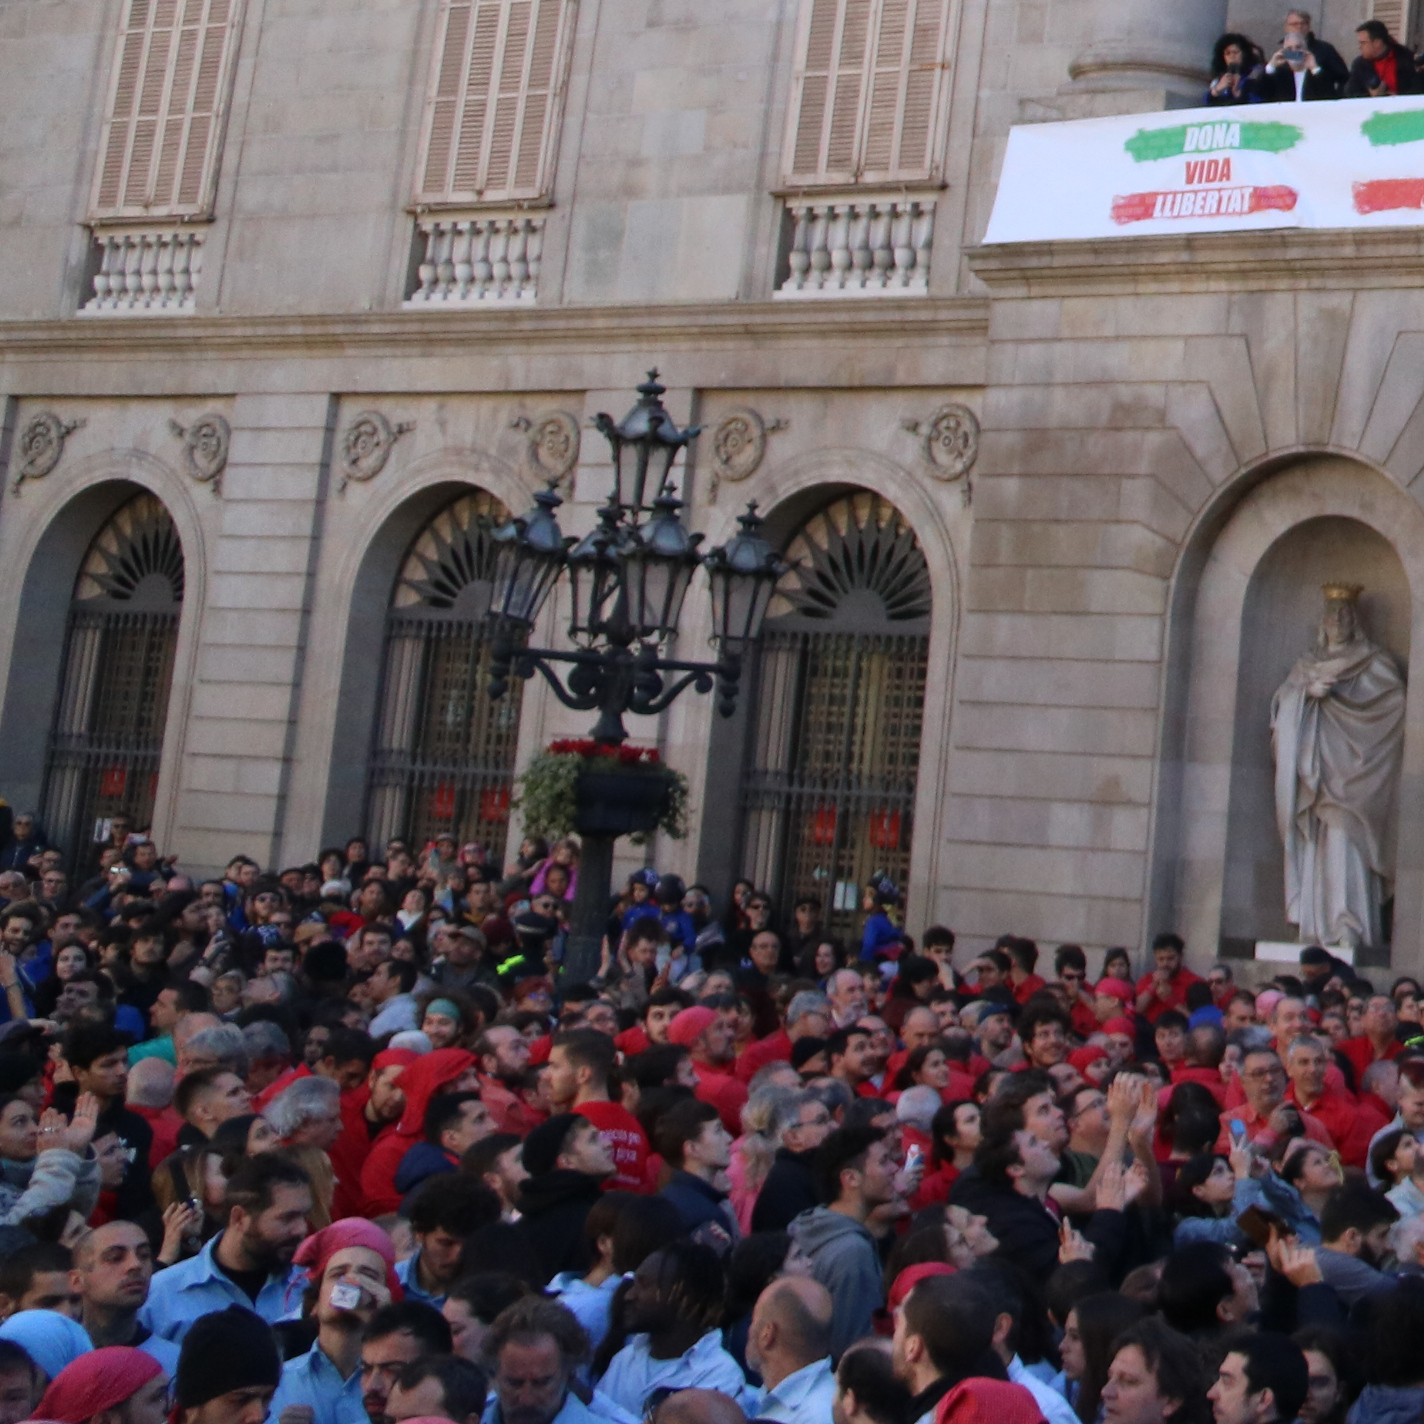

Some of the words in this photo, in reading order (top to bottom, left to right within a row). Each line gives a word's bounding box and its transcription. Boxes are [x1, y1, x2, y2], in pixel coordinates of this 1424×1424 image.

[1183, 122, 1240, 152] DONA
[1185, 157, 1232, 185] VIDA
[1152, 185, 1254, 218] LLIBERTAT
